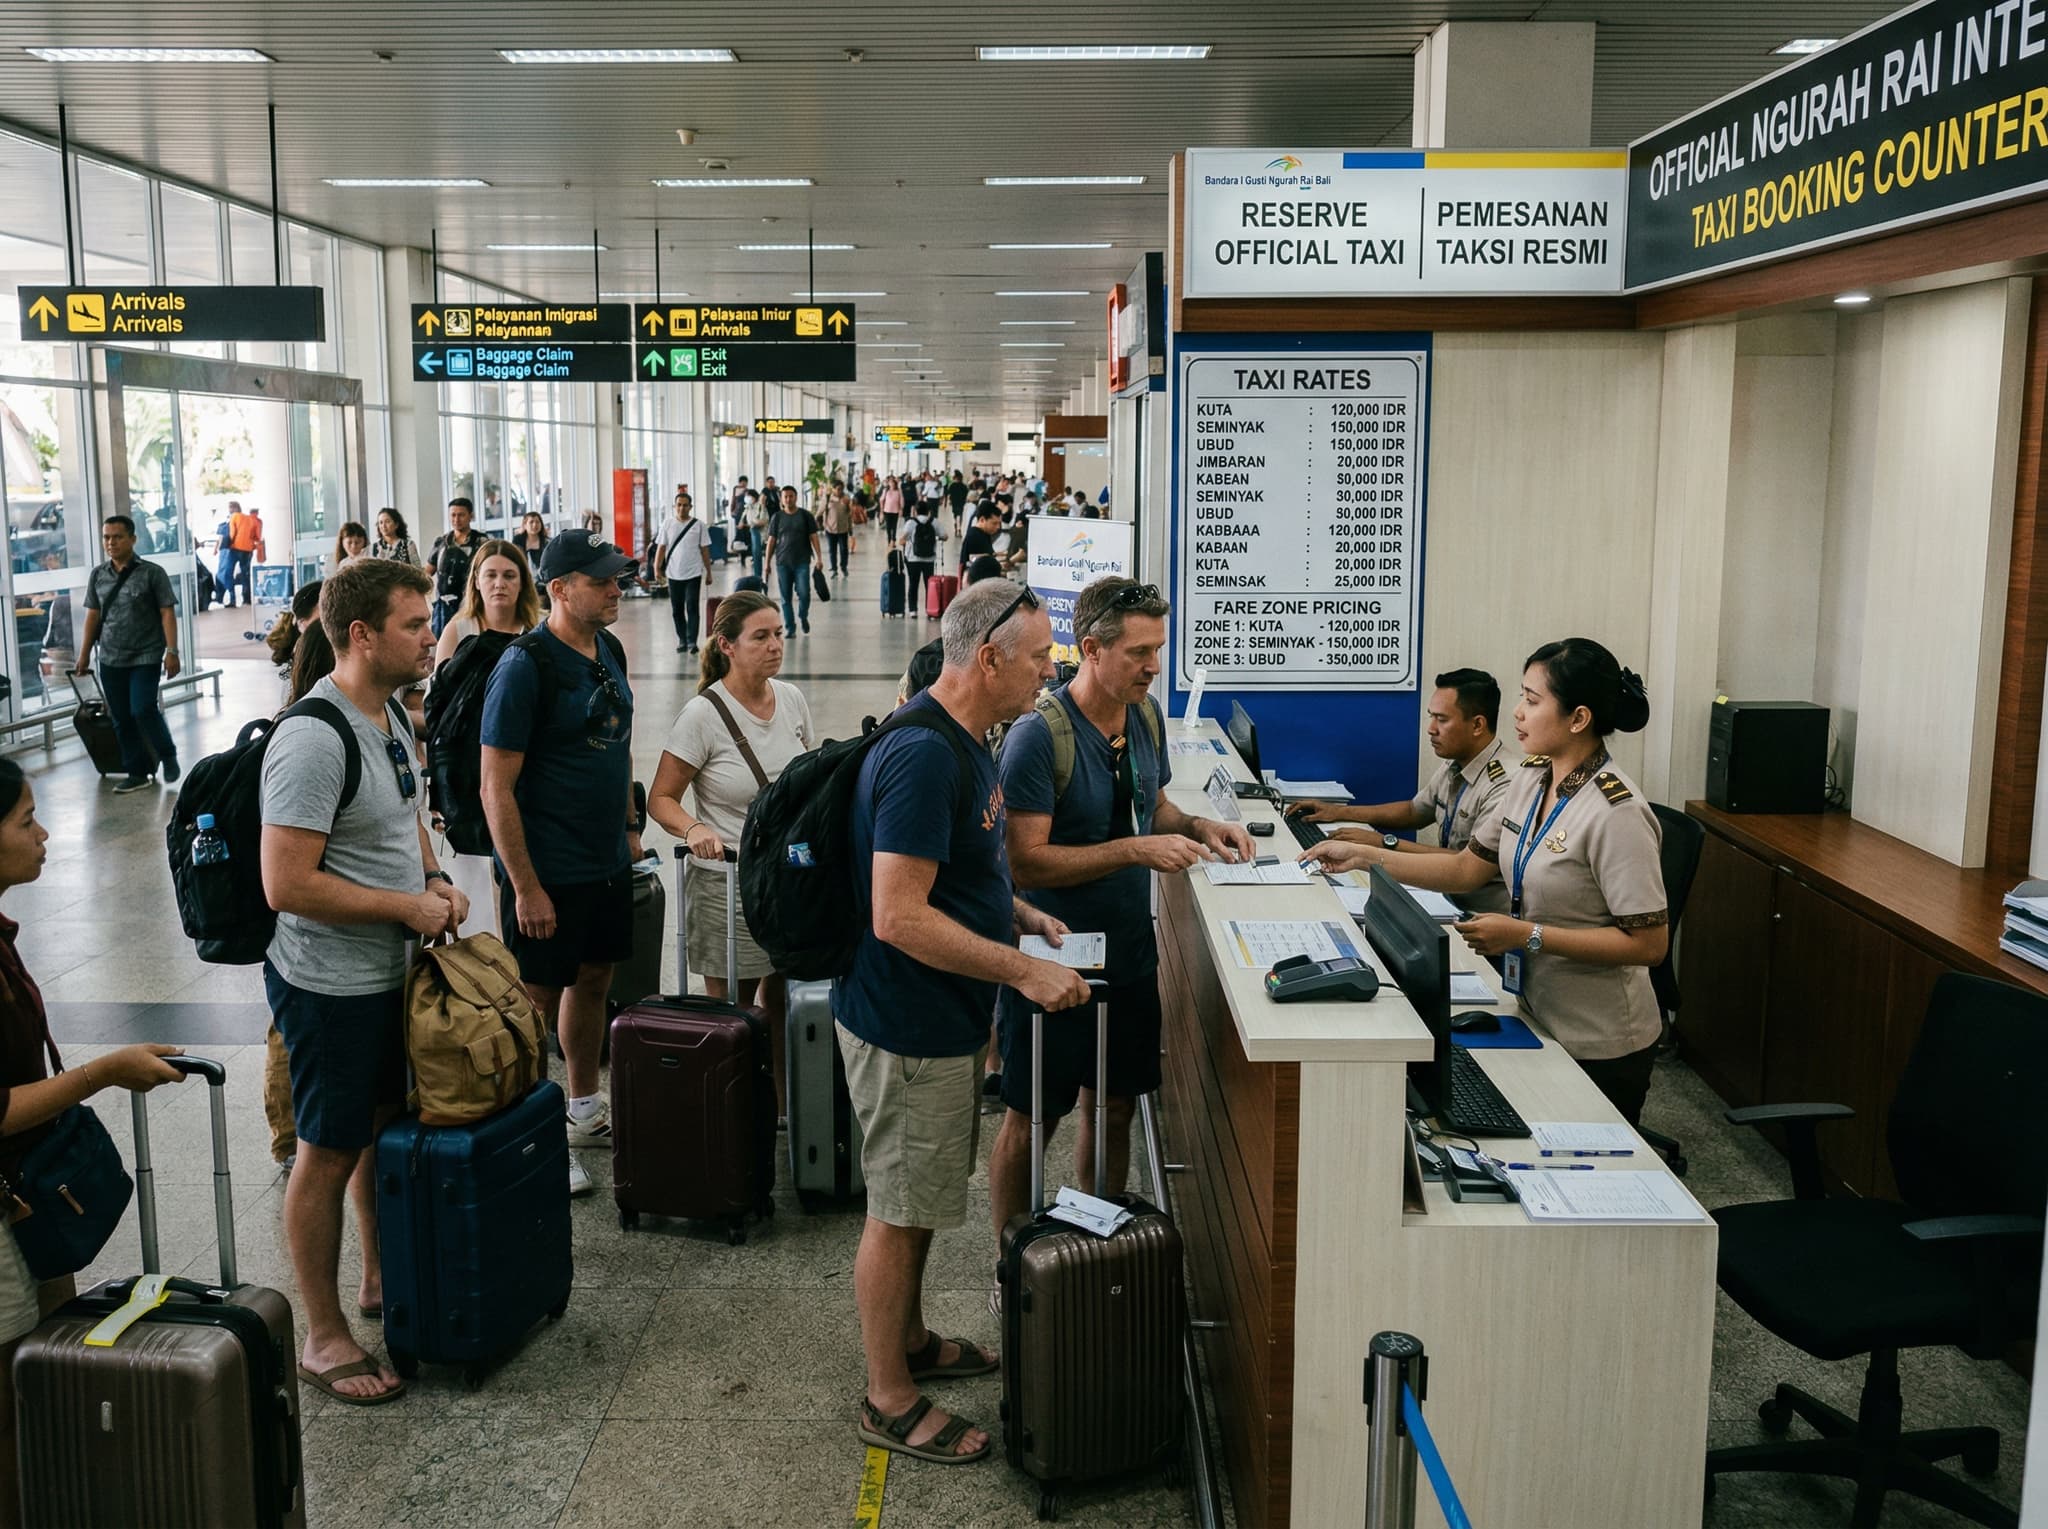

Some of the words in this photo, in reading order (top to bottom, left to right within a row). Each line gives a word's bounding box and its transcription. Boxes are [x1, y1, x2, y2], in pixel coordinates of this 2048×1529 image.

[1650, 121, 1745, 201] OFFICIAL
[1751, 62, 1871, 163] NGURAH
[1881, 31, 1943, 112] RAI
[1692, 194, 1738, 249] TAXI
[1743, 150, 1865, 235] BOOKING
[1874, 86, 2048, 194] COUNTER
[1205, 176, 1238, 185] Bandara
[1245, 176, 1266, 185] Gusti
[1269, 176, 1298, 187] Ngurah
[1300, 176, 1313, 184] Rai
[1316, 176, 1330, 184] Bali
[1242, 202, 1367, 227] RESERVE
[1438, 201, 1608, 226] PEMESANAN
[1215, 240, 1338, 265] OFFICIAL
[1346, 240, 1403, 264] TAXI
[1437, 239, 1513, 264] TAKSI
[1524, 239, 1607, 264] RESMI
[112, 293, 185, 310] Arrivals
[475, 308, 541, 324] Pelayanan
[113, 315, 183, 332] Arrivals
[701, 323, 751, 336] Arrivals
[475, 347, 534, 364] Baggage
[535, 347, 574, 362] Claim
[701, 348, 728, 361] Exit
[476, 363, 531, 380] Baggage
[533, 363, 570, 377] Claim
[701, 364, 728, 377] Exit
[1234, 370, 1284, 390] TAXI
[1294, 369, 1370, 390] RATES
[1197, 404, 1232, 416] KUTA
[1332, 403, 1379, 417] 120,000
[1384, 403, 1406, 415] IDR
[1197, 421, 1264, 433] SEMINYAK
[1331, 421, 1378, 434] 150,000
[1383, 421, 1405, 432] IDR
[1197, 439, 1234, 450] UBUD
[1331, 438, 1378, 452] 150,000
[1382, 438, 1404, 450] IDR
[1196, 456, 1265, 468] JIMBARAN
[1338, 456, 1377, 469] 20,000
[1382, 456, 1404, 467] IDR
[1197, 473, 1249, 485] KABEAN
[1382, 473, 1404, 484] IDR
[1196, 490, 1263, 502] SEMINYAK
[1381, 490, 1403, 502] IDR
[1197, 508, 1233, 519] UBUD
[1381, 507, 1403, 519] IDR
[1197, 525, 1260, 536] KABBAAA
[1329, 524, 1376, 538] 120,000
[1380, 524, 1402, 536] IDR
[1196, 542, 1247, 553] KABAAN
[1336, 541, 1375, 554] 20,000
[1380, 542, 1402, 553] IDR
[1196, 559, 1229, 570] KUTA
[1335, 558, 1375, 571] 20,000
[1379, 559, 1401, 570] IDR
[1196, 576, 1266, 587] SEMINSAK
[1335, 575, 1375, 588] 25,000
[1379, 575, 1401, 586] IDR
[1215, 601, 1257, 614] FARE
[1262, 601, 1307, 614] ZONE
[1313, 601, 1381, 614] PRICING
[1195, 620, 1230, 632] ZONE
[1235, 620, 1244, 631] 1:
[1250, 620, 1283, 631] KUTA
[1328, 620, 1374, 634] 120,000
[1379, 620, 1400, 631] IDR
[1194, 637, 1230, 648] ZONE
[1234, 637, 1244, 648] 2:
[1249, 637, 1315, 648] SEMINYAK
[1327, 637, 1373, 650] 150,000
[1378, 637, 1399, 648] IDR
[1194, 654, 1230, 665] ZONE
[1234, 654, 1244, 665] 3:
[1249, 653, 1285, 665] UBUD
[1327, 653, 1373, 666] 350,000
[1377, 654, 1399, 665] IDR
